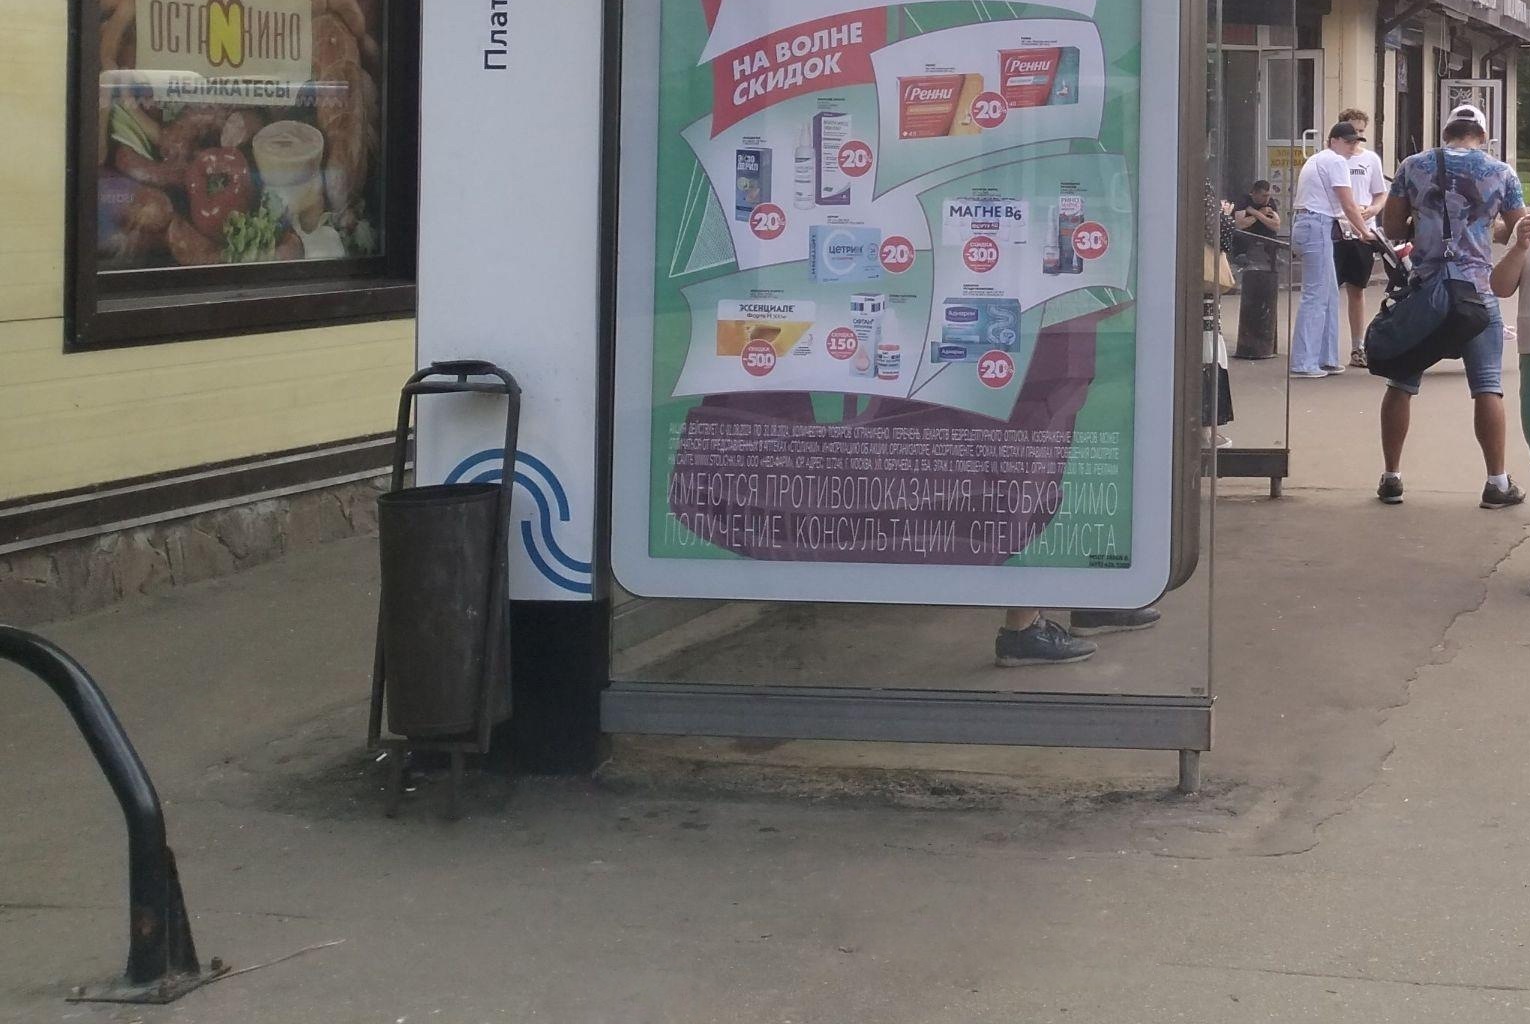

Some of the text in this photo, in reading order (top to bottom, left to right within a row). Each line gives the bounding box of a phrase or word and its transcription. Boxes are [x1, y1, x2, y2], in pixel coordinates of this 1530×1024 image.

[732, 21, 863, 81] НА ВОЛНЕ
[1010, 59, 1051, 73] Ренни
[166, 78, 291, 100] ДЕЛИКАТЕСЫ
[733, 51, 842, 106] СКИДОК
[909, 87, 953, 101] Ренни
[949, 205, 1002, 218] МАГНЕ
[666, 472, 1119, 517] ИМЕЮТСЯ ПРОТИВОПОКАЗАНИЯ. НЕОБХОДИМО
[664, 512, 1118, 559] ПОЛУЧЕНИЕ КОНСУЛЬТАЦИИ СПЕЦИАЛИСТА
